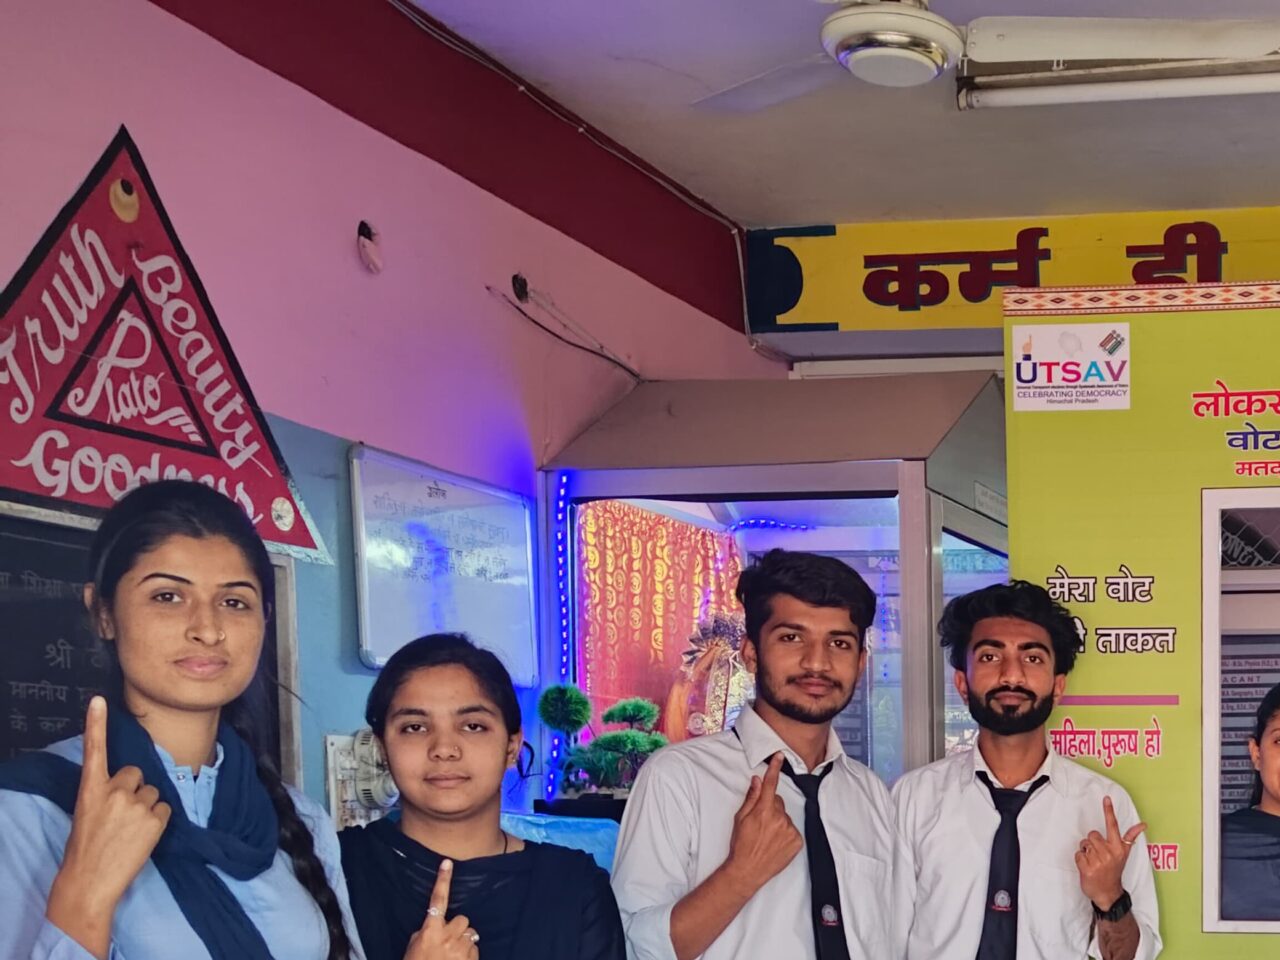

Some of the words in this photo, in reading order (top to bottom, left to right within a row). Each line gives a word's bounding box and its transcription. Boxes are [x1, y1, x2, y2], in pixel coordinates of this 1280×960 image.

[863, 227, 1051, 311] कर्म
[0, 222, 125, 424] Truth
[67, 310, 166, 425] Plato
[132, 248, 273, 478] Beauty
[1016, 360, 1128, 383] UTSAV
[1017, 390, 1074, 399] CELEBRATING
[1075, 389, 1128, 398] DEMOCRACY
[1046, 565, 1097, 602] मेरा
[1105, 564, 1154, 602] वोट
[43, 638, 75, 669] श्री
[1095, 627, 1176, 653] ताकत
[8, 680, 70, 703] माननीय
[1221, 675, 1262, 683] ACANT
[1144, 716, 1162, 758] हो
[1147, 844, 1179, 870] शत
